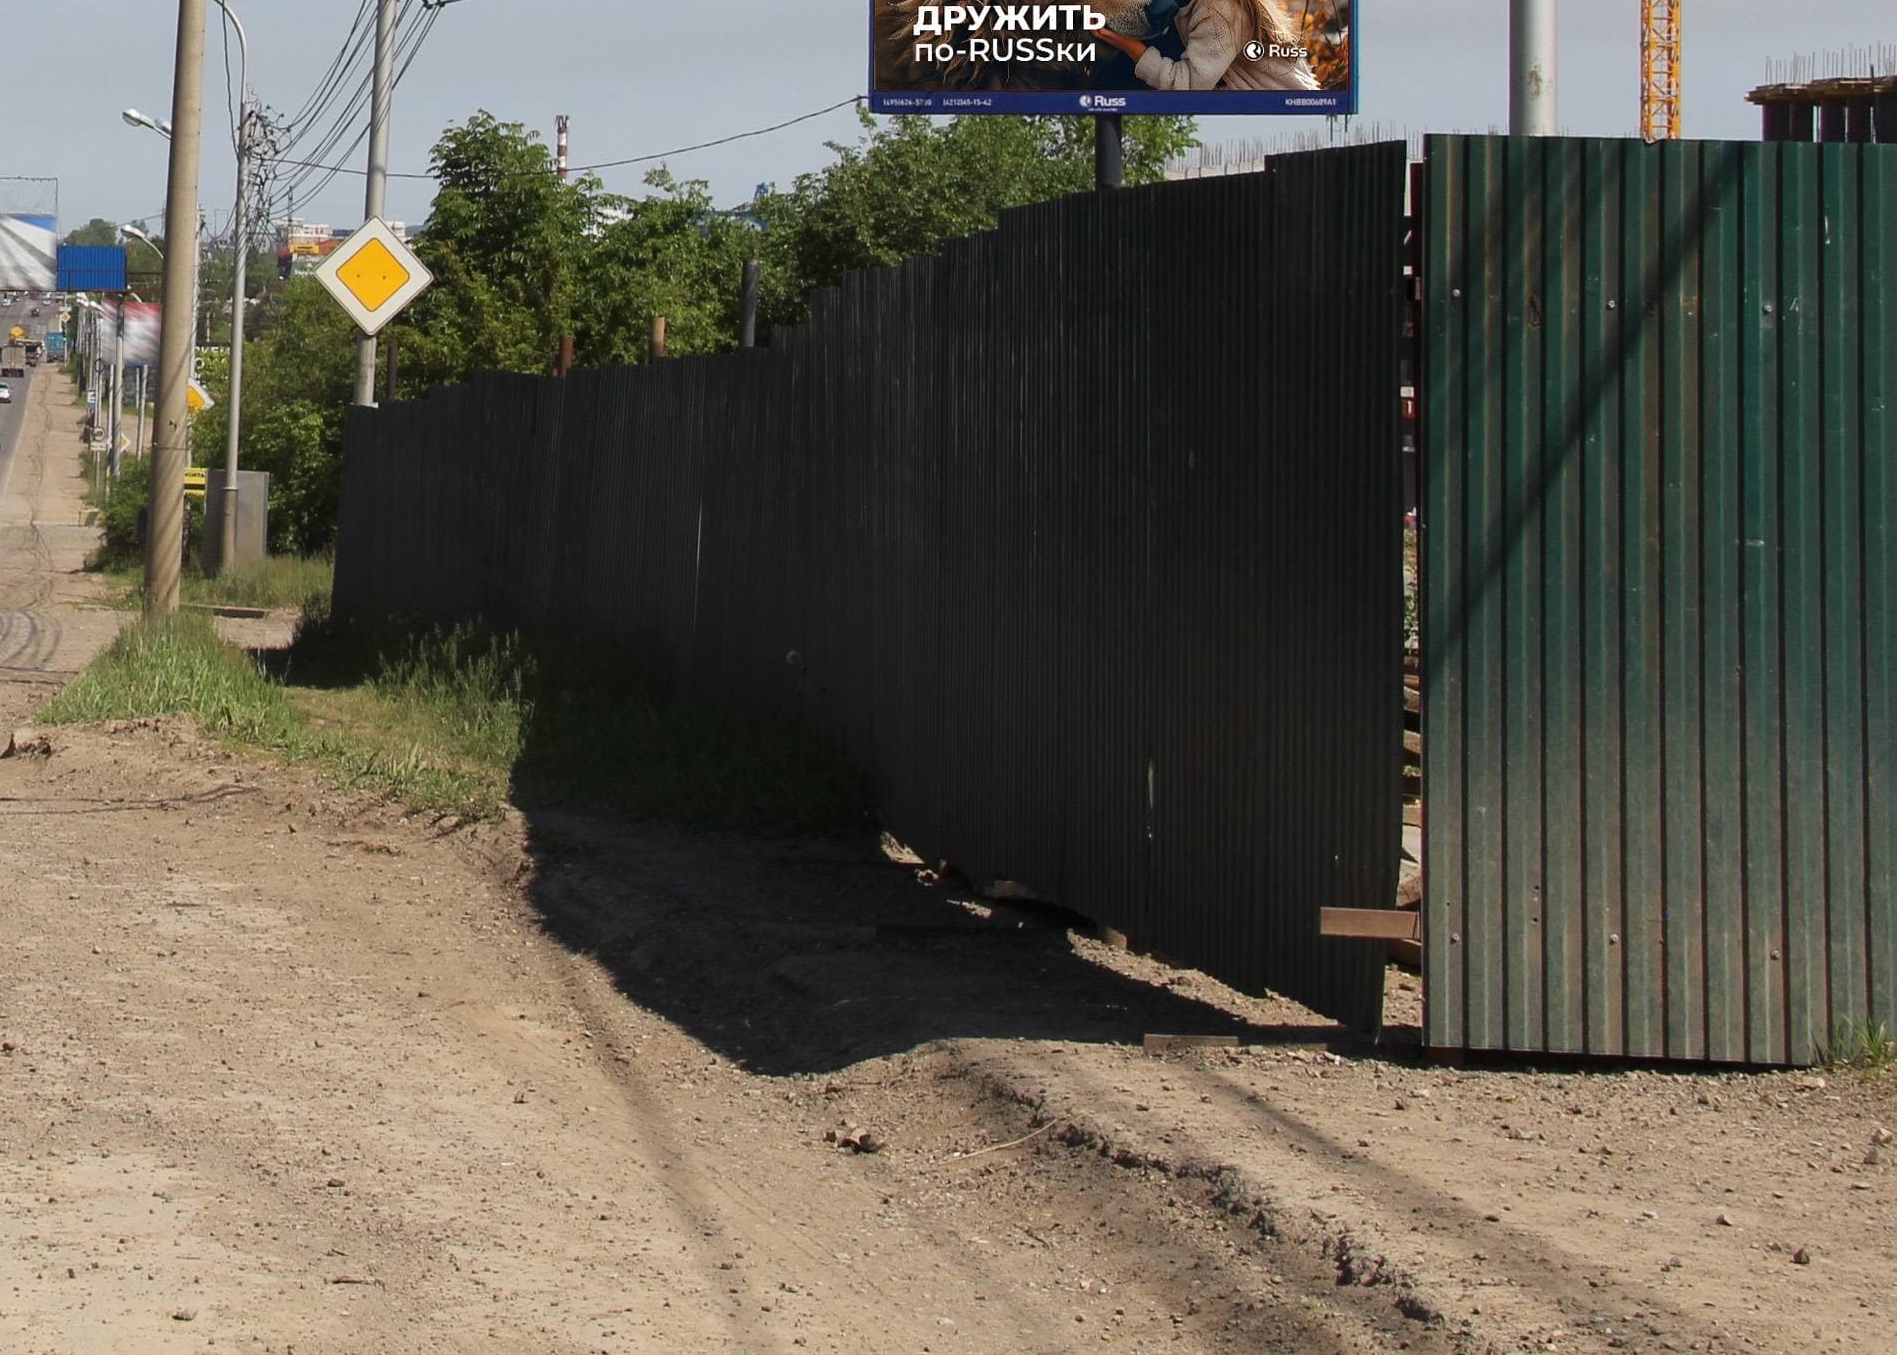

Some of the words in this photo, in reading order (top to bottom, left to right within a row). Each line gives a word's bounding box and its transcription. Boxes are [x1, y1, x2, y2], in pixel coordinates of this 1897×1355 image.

[913, 4, 1106, 36] ДРУЖИТЬ
[915, 37, 1096, 62] по-RUSSки
[1268, 44, 1308, 57] Russ
[1094, 95, 1126, 107] Russ
